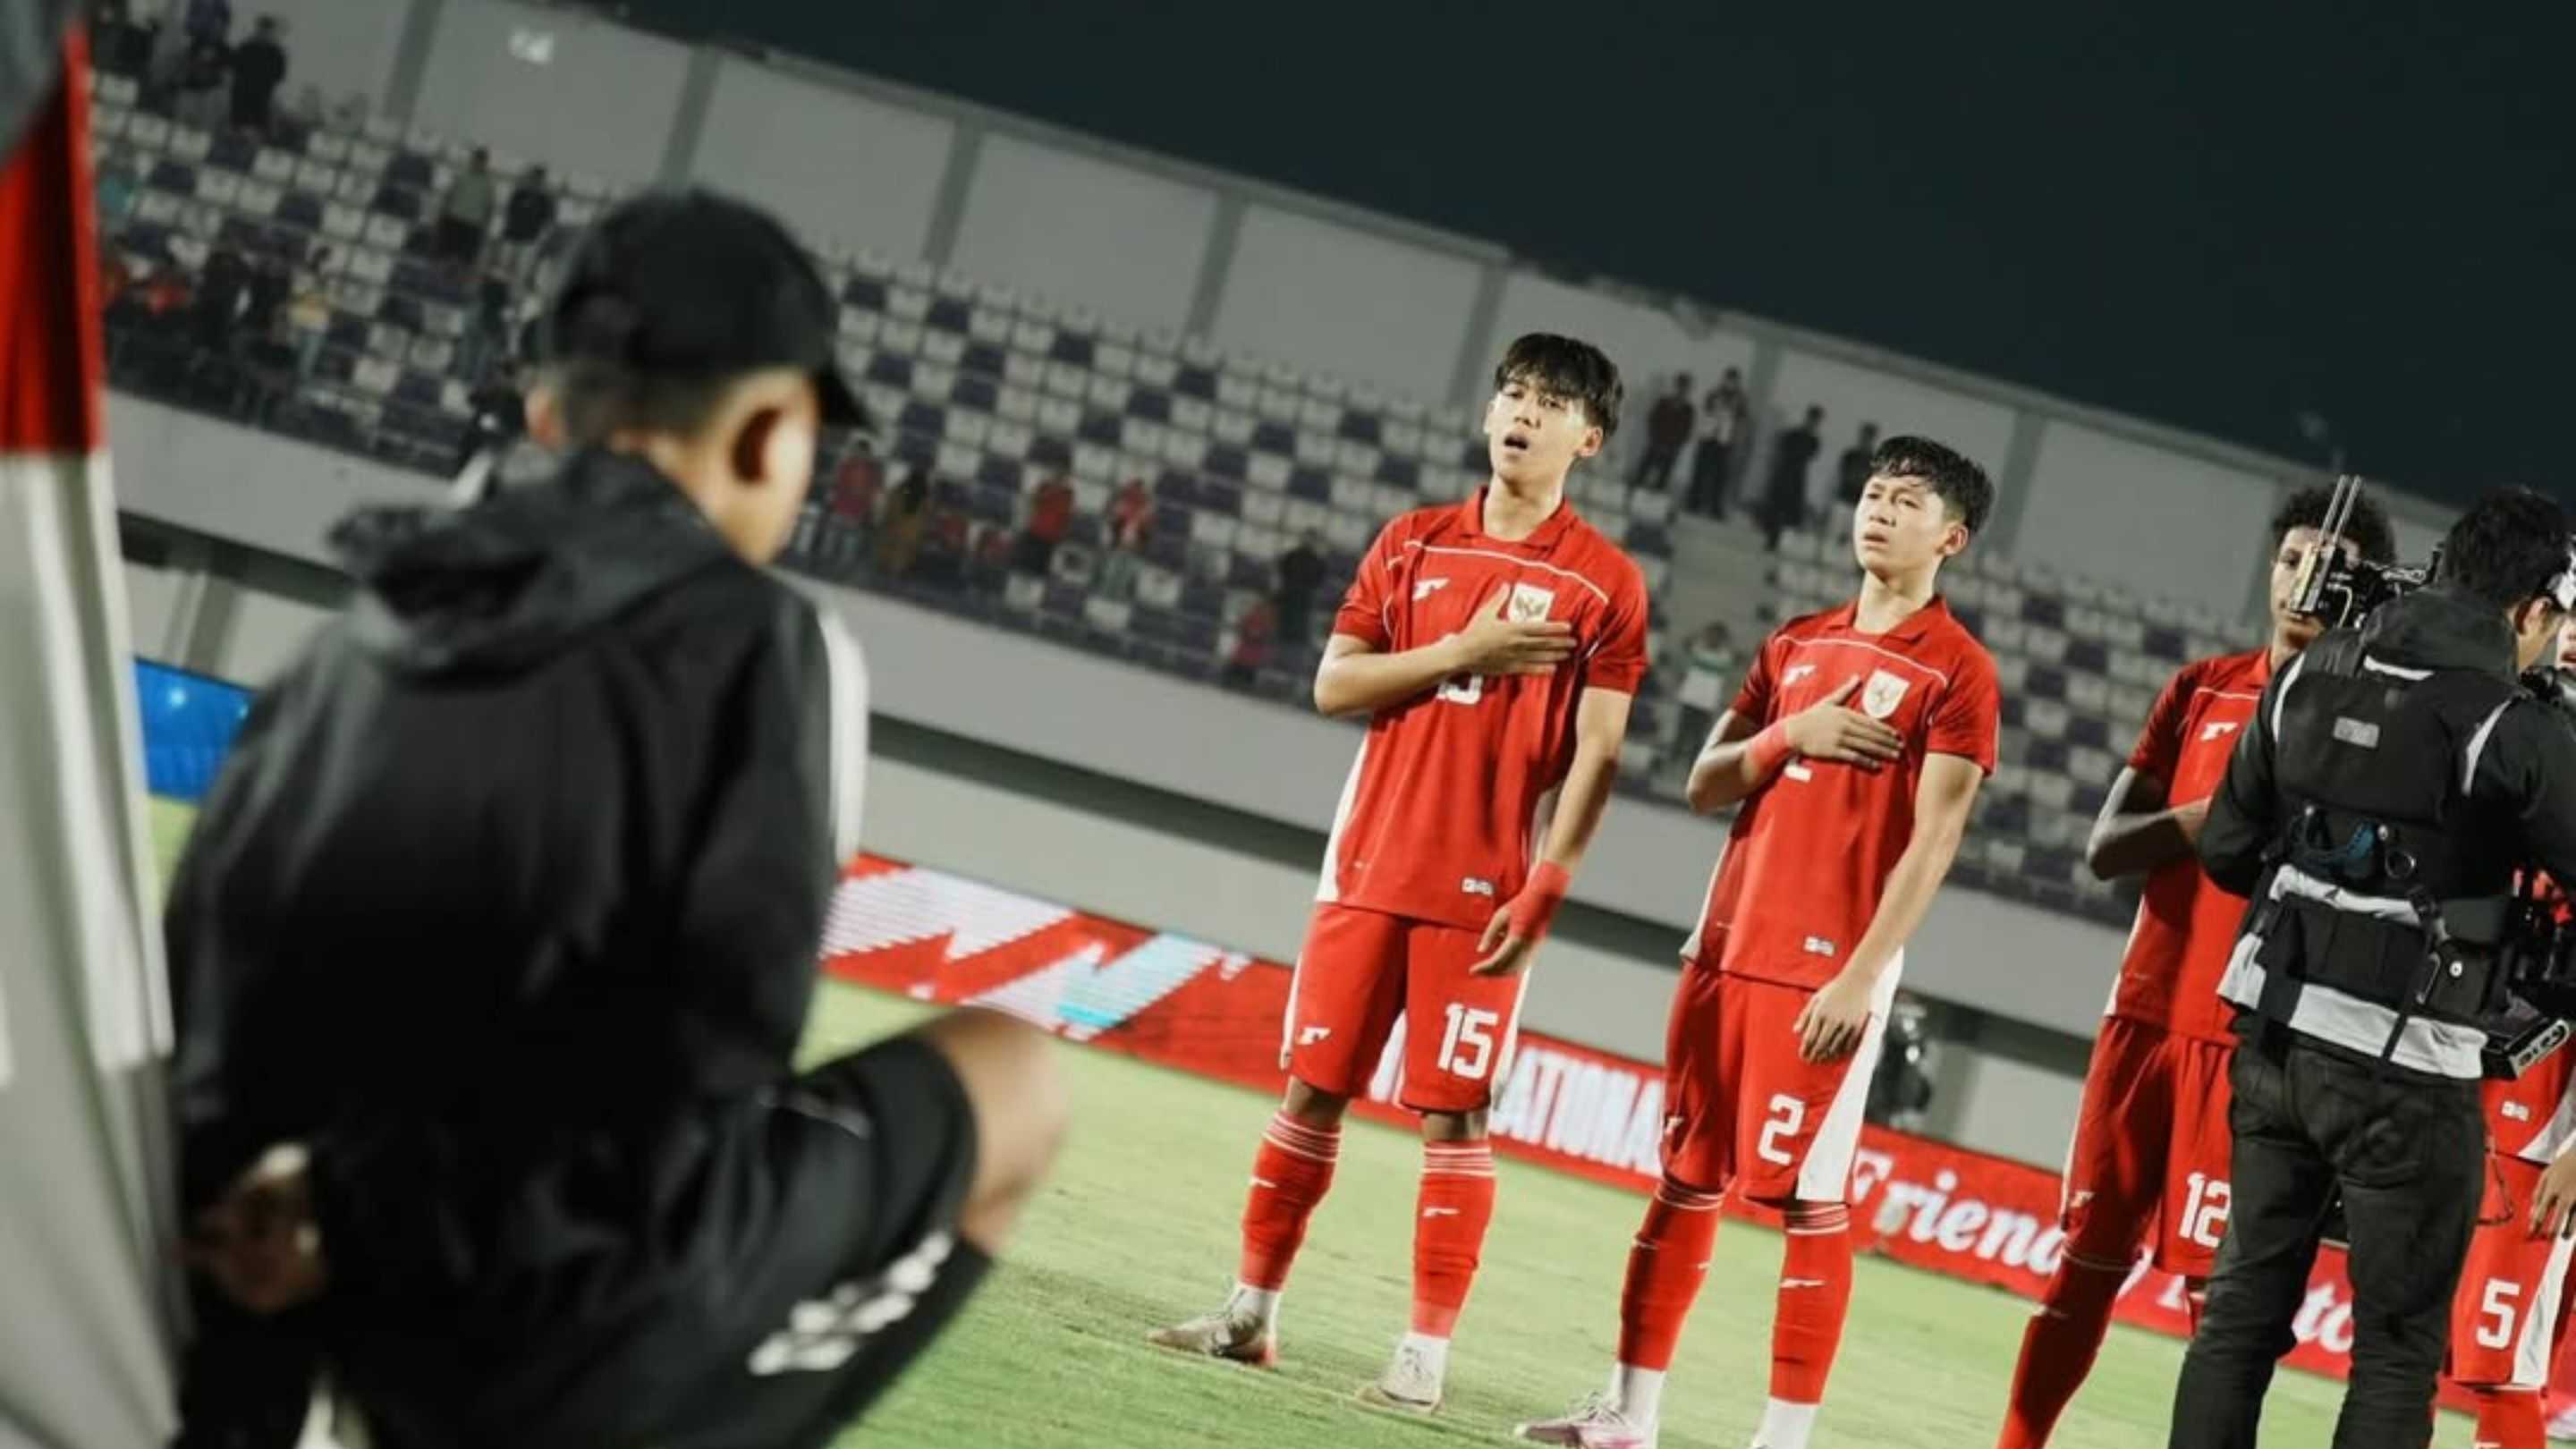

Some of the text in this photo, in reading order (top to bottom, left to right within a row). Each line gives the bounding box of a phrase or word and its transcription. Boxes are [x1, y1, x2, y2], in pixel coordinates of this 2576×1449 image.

[1437, 1003, 1499, 1080] 15
[1758, 1093, 1805, 1166] 2
[2179, 1172, 2232, 1248] 12
[2476, 1276, 2521, 1350] 5
